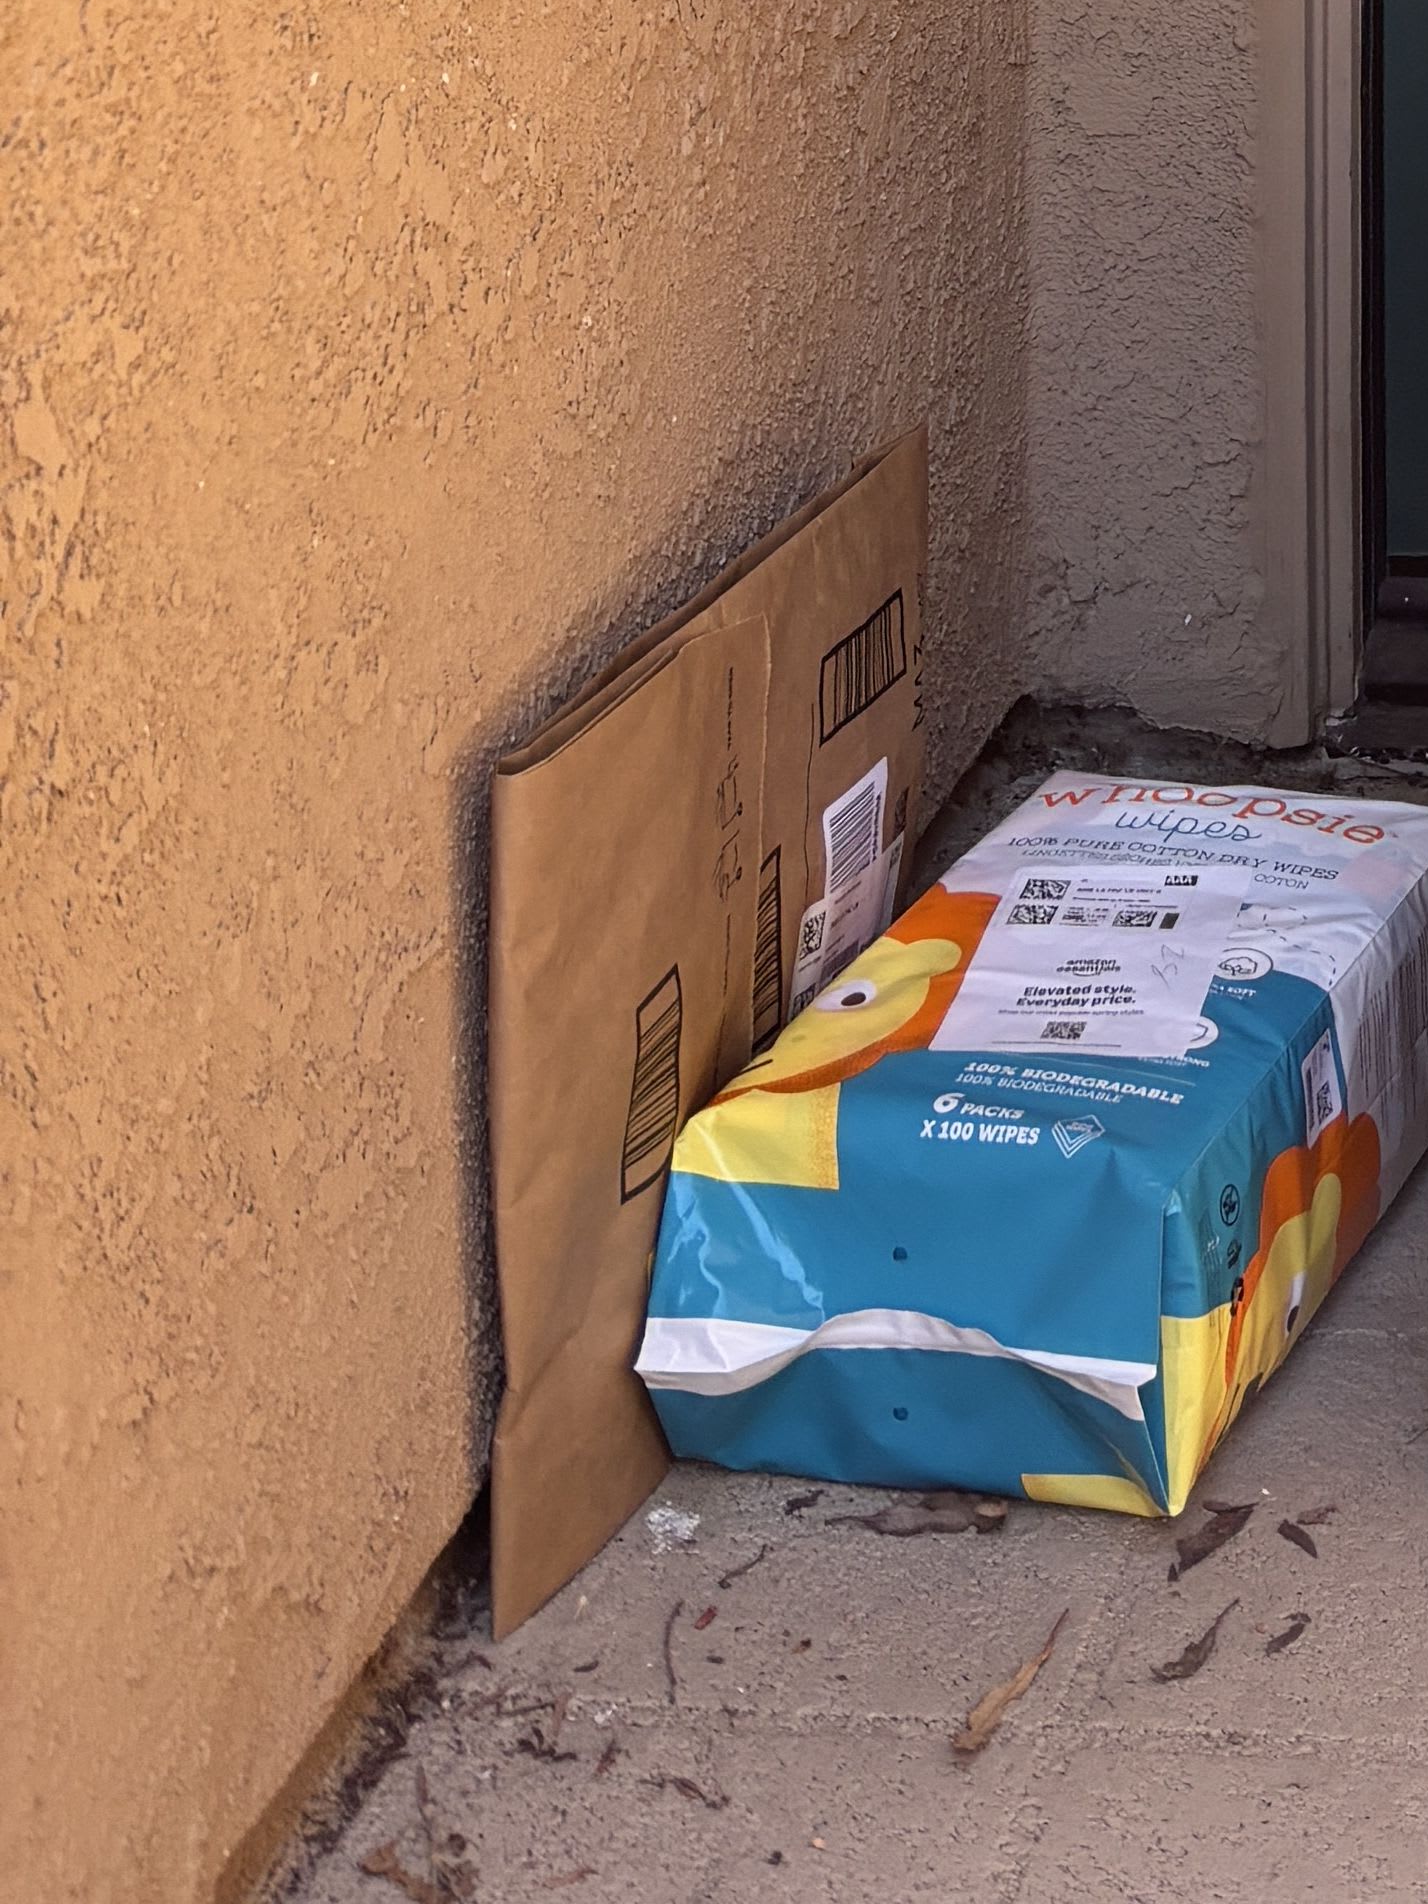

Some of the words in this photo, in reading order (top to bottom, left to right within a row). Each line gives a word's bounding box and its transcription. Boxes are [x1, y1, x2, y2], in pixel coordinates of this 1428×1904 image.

[1115, 808, 1262, 843] wipes
[1008, 837, 1058, 846] 100%
[1064, 838, 1125, 851] PURE
[1128, 842, 1217, 862] COTTON
[1218, 854, 1268, 868] DRY
[1273, 860, 1339, 880] WIPES
[1254, 873, 1309, 890] COTON
[1016, 996, 1089, 1008] Everyday
[1091, 995, 1136, 1007] price.
[1024, 984, 1092, 997] Elevated
[1094, 984, 1136, 995] style.
[955, 1073, 993, 1086] 100%
[997, 1076, 1124, 1104] BIODEGRADABLE
[964, 1062, 1015, 1076] 100%
[1021, 1068, 1184, 1104] BIODEGRADABLE
[933, 1093, 966, 1114] 6
[960, 1102, 1025, 1120] PACKS
[920, 1120, 935, 1139] X
[940, 1121, 974, 1141] 100
[979, 1124, 1041, 1145] WIPES
